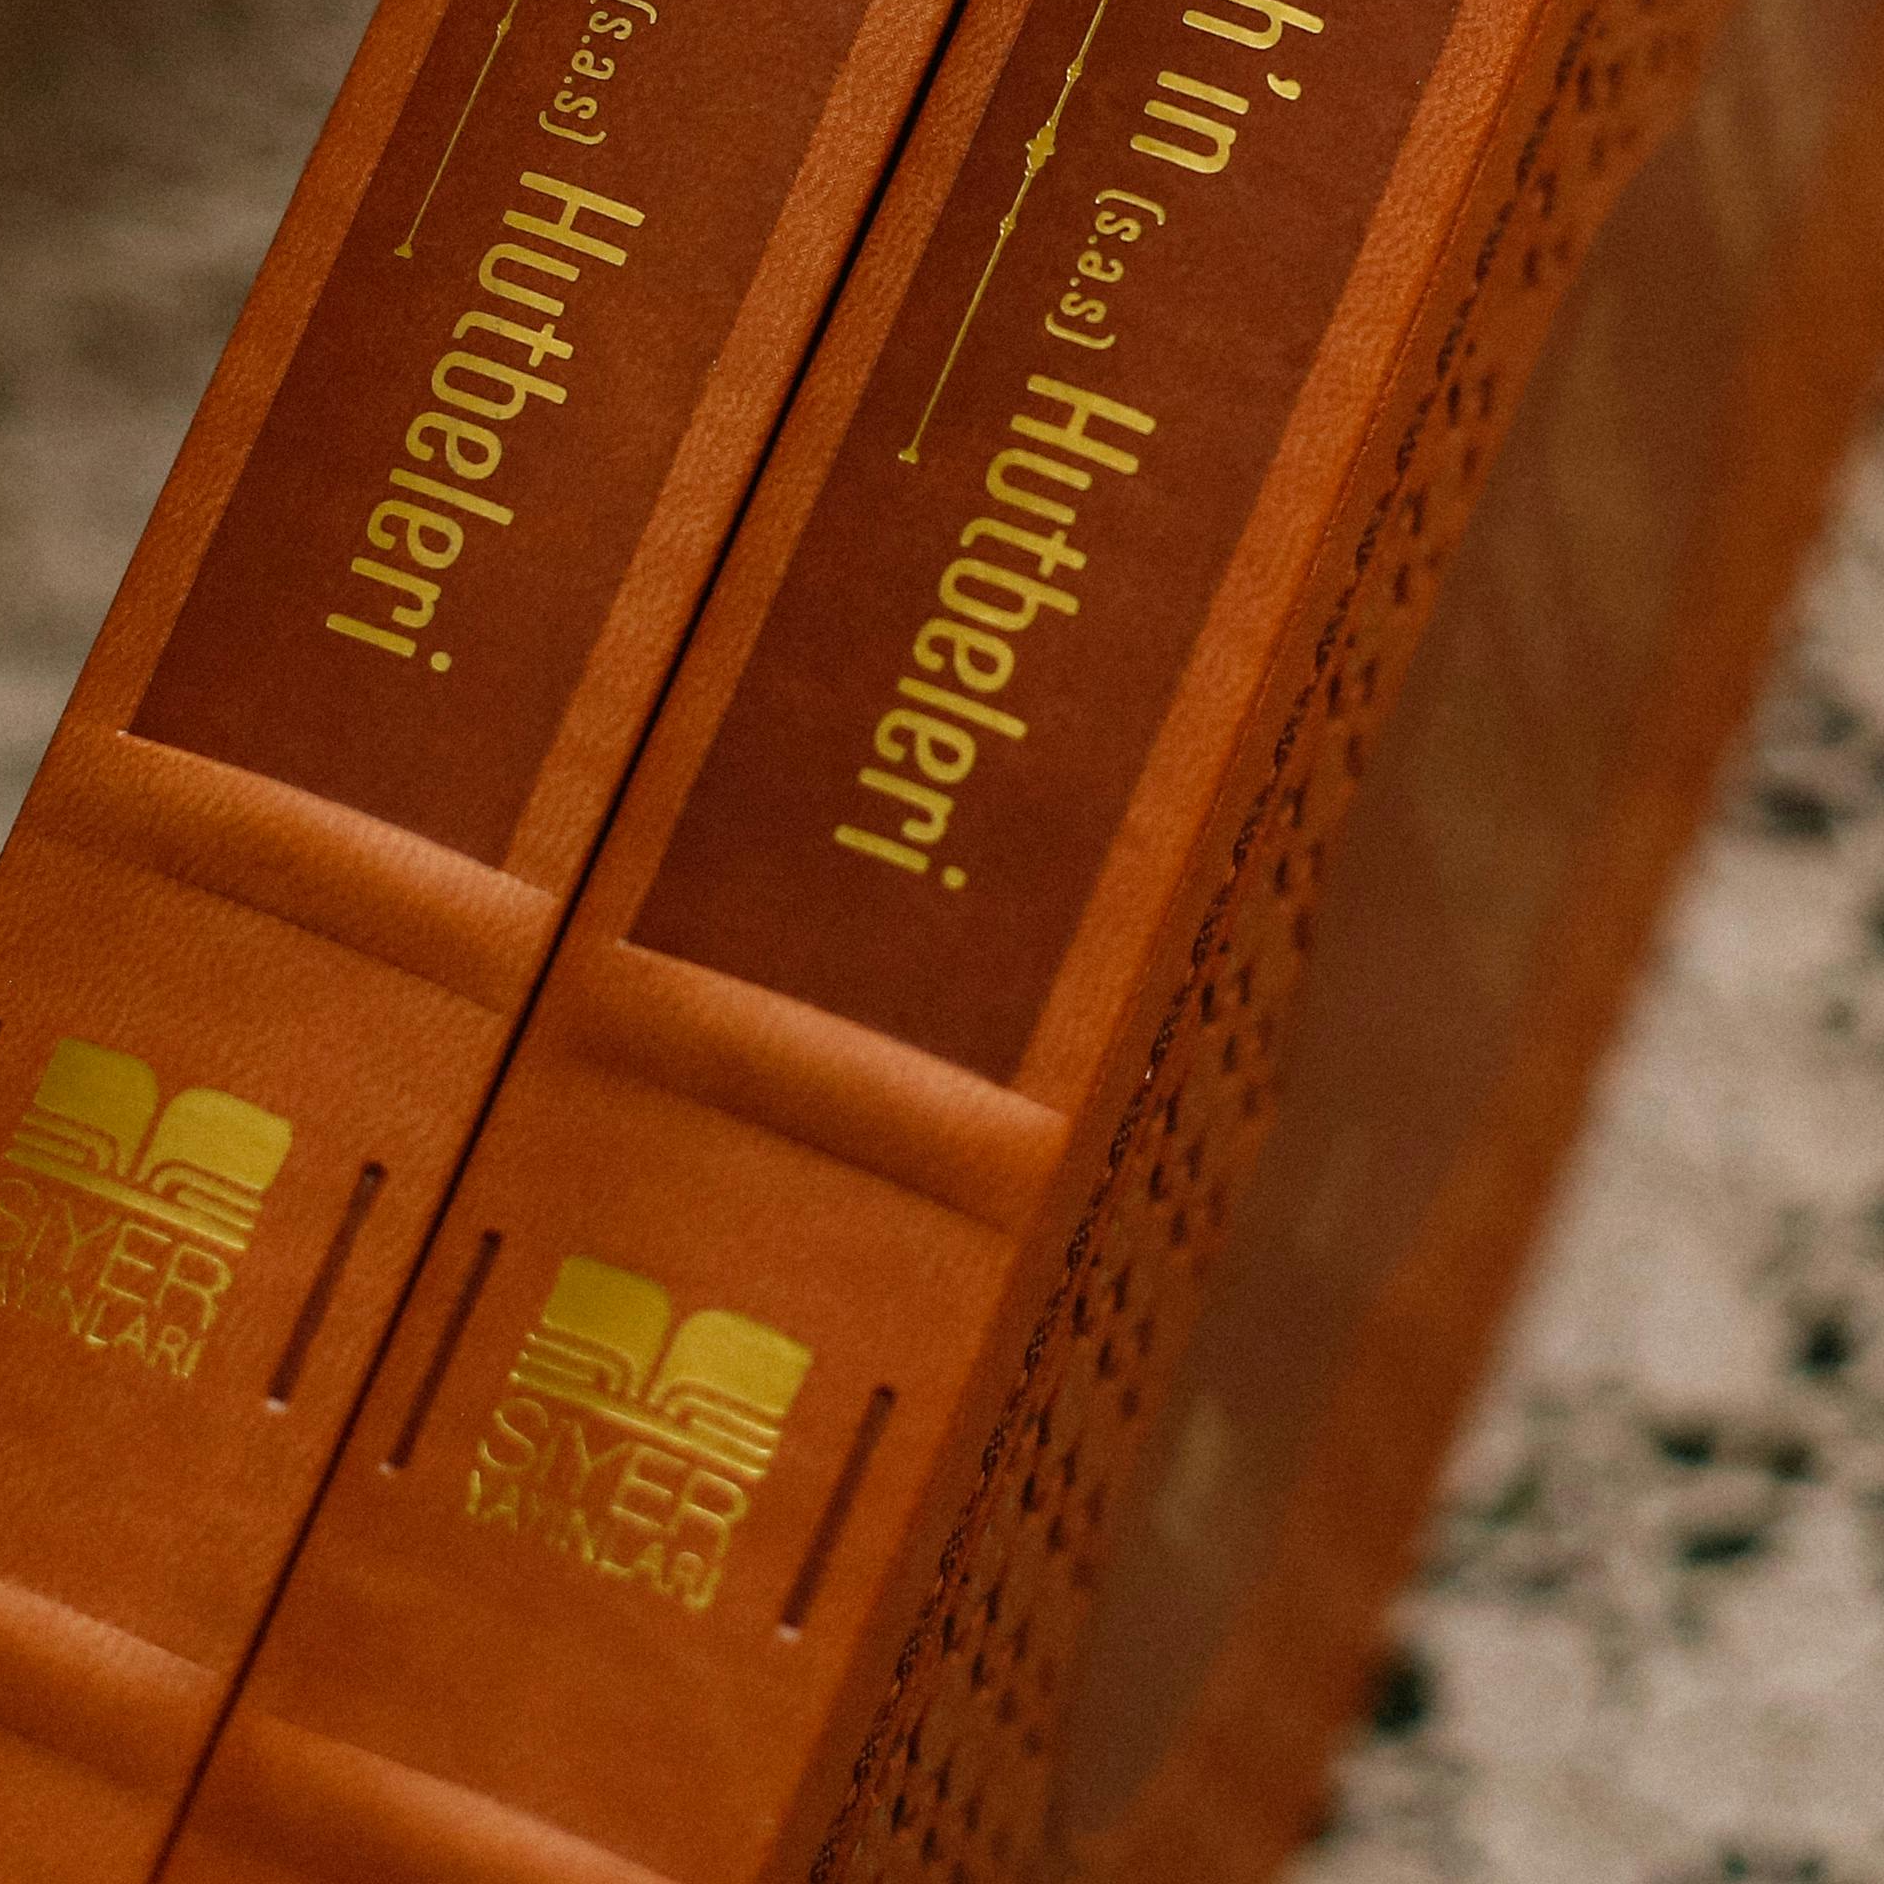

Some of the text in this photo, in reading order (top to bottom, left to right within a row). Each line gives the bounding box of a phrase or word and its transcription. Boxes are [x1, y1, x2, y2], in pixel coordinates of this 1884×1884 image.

[325, 168, 645, 675] Hutbeleri
[1045, 189, 1166, 350] (s.a.s)
[834, 373, 1158, 891] Hutbeleri
